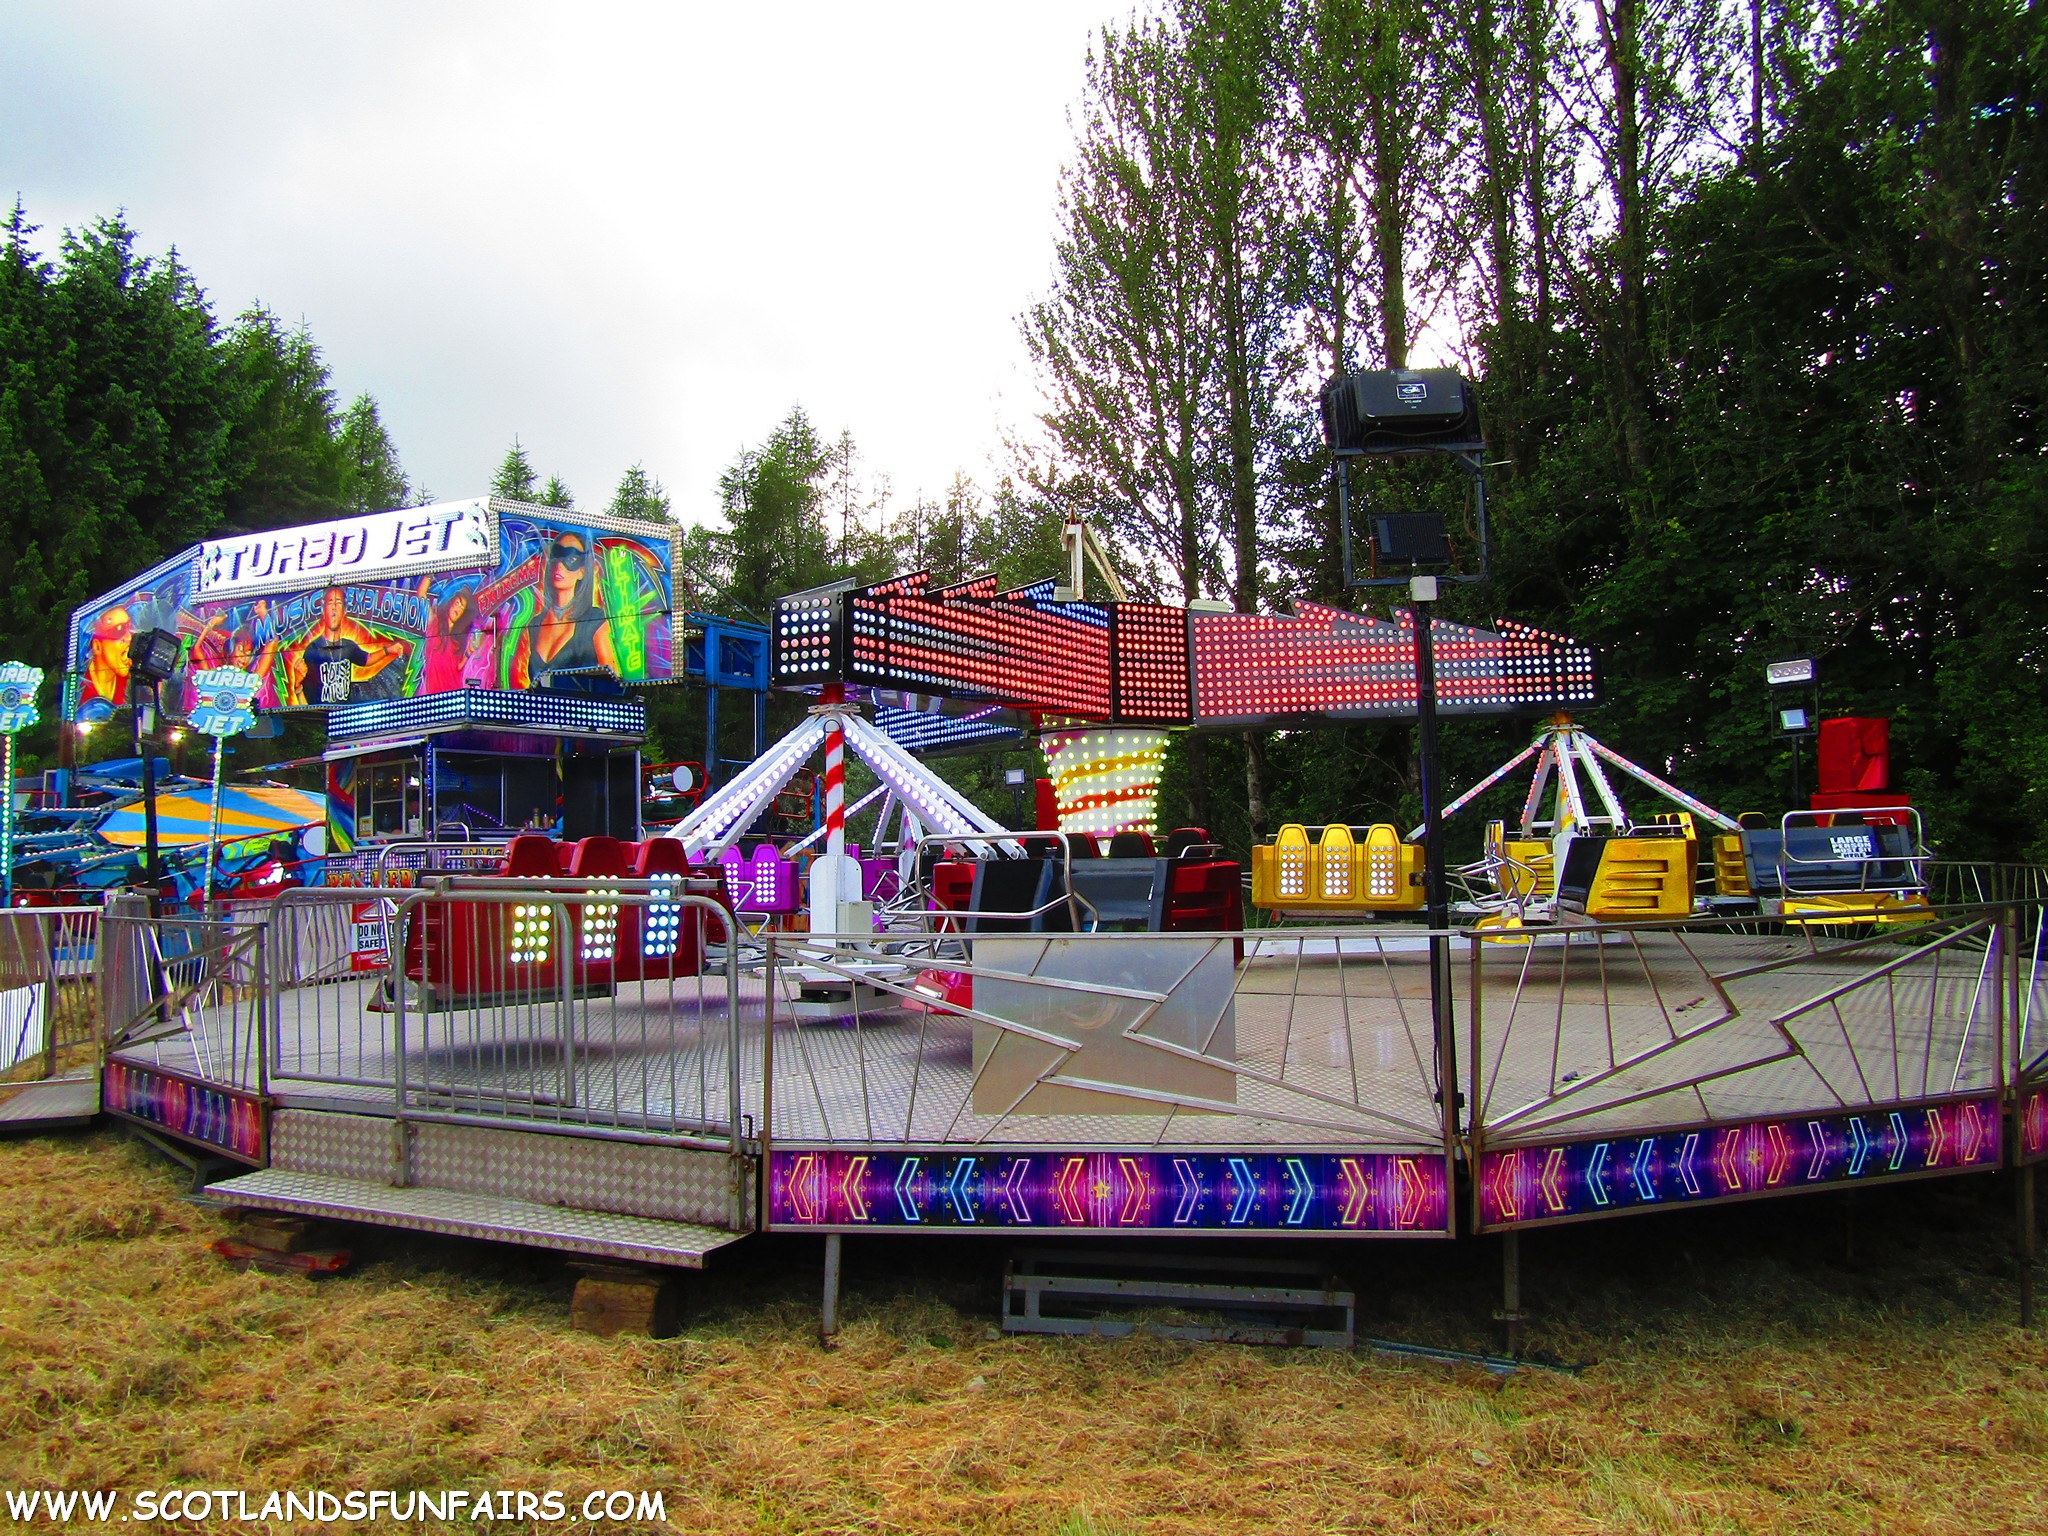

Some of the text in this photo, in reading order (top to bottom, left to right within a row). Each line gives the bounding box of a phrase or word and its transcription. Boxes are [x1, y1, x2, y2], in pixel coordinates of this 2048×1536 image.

[219, 510, 465, 578] TURBO JET
[478, 560, 538, 612] EXTREME
[254, 589, 325, 647] MUSIC
[345, 586, 430, 632] EXPLOSION
[610, 546, 644, 672] ULTIMATE
[195, 670, 259, 688] TURBO
[319, 658, 351, 684] HOUSE
[0, 711, 28, 731] ET
[200, 715, 246, 734] JET
[1829, 835, 1870, 843] LARGE
